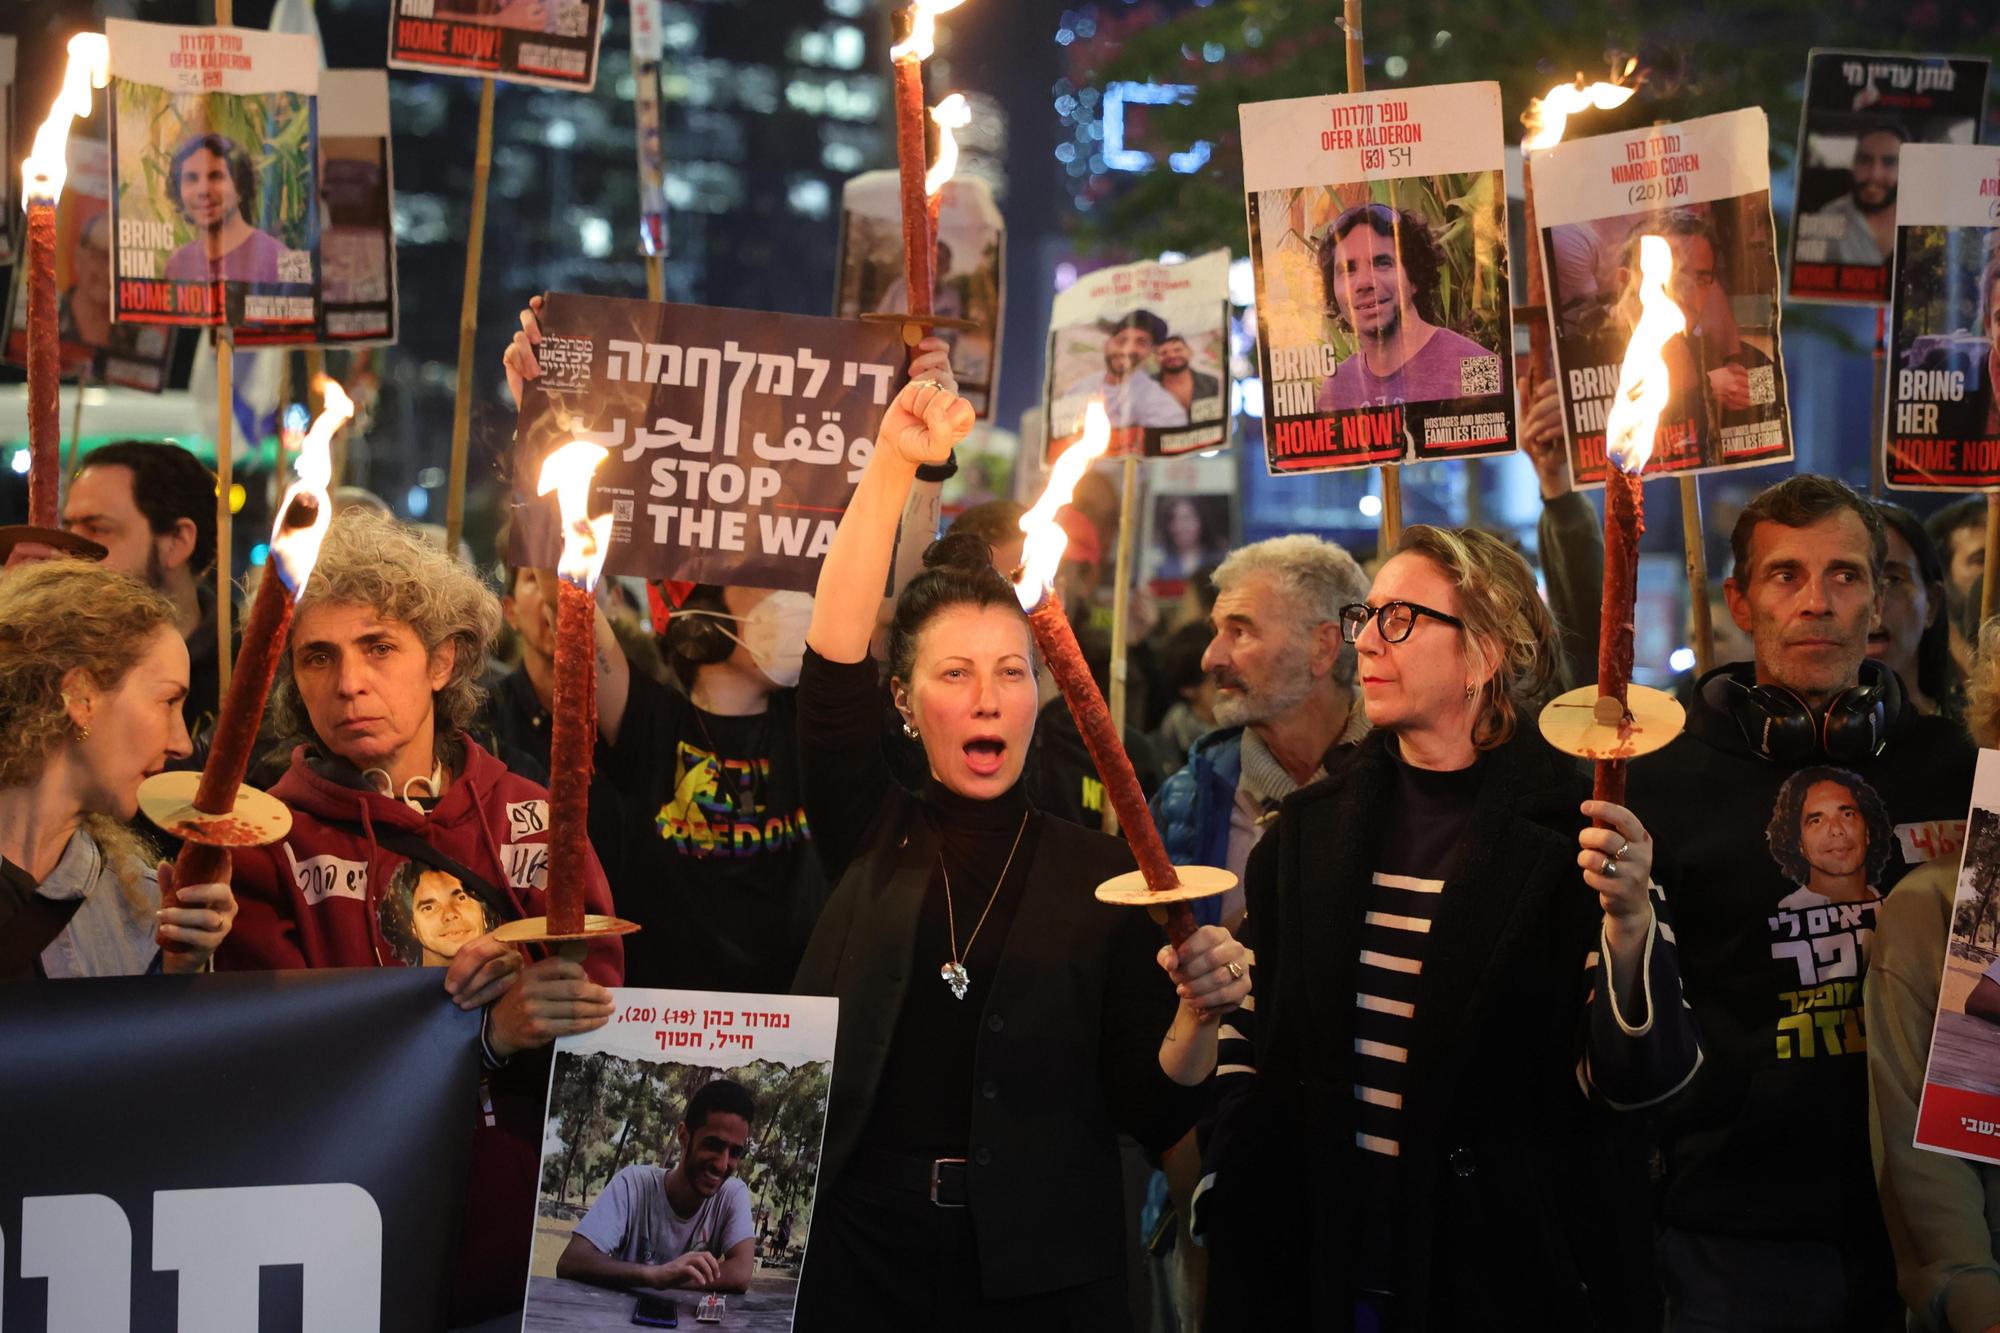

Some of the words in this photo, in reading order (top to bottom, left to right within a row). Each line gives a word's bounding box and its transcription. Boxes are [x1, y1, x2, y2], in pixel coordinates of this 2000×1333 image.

[399, 20, 448, 51] HOME
[452, 26, 503, 58] NOW!
[1332, 105, 1373, 129] קלדרון
[1377, 102, 1408, 123] עופר
[1321, 130, 1353, 151] OFER
[1357, 124, 1422, 147] KALDERON
[1625, 141, 1646, 162] כהן
[1650, 135, 1681, 156] נמרוד
[1388, 146, 1411, 167] 54
[1611, 160, 1658, 184] NIMROD
[1660, 153, 1699, 176] COHEN
[1628, 182, 1663, 205] (20)
[1979, 179, 2000, 197] AR
[120, 221, 173, 249] BRING
[119, 250, 156, 279] HIM
[120, 281, 172, 311] HOME
[176, 285, 224, 314] NOW!
[1271, 344, 1337, 382] BRING
[607, 339, 830, 452] למלחמה
[842, 361, 895, 405] די
[1568, 364, 1622, 401] BRIN
[1898, 369, 1965, 401] BRING
[1272, 382, 1316, 417] HIM
[1275, 418, 1338, 455] HOME
[1341, 406, 1401, 449] NOW!
[1896, 403, 1938, 434] HER
[752, 411, 874, 484] وقف
[1424, 425, 1470, 445] FAMILIES
[1578, 435, 1607, 468] HO
[1894, 439, 1957, 471] HOME
[649, 457, 782, 506] STOP
[647, 503, 748, 552] THE
[758, 513, 838, 558] WA
[512, 801, 543, 834] 98
[1768, 911, 1801, 937] לי
[703, 1010, 733, 1030] כהן
[741, 1012, 790, 1028] נמרוד
[655, 1030, 702, 1050] חטוף
[709, 1030, 753, 1050] חייל,
